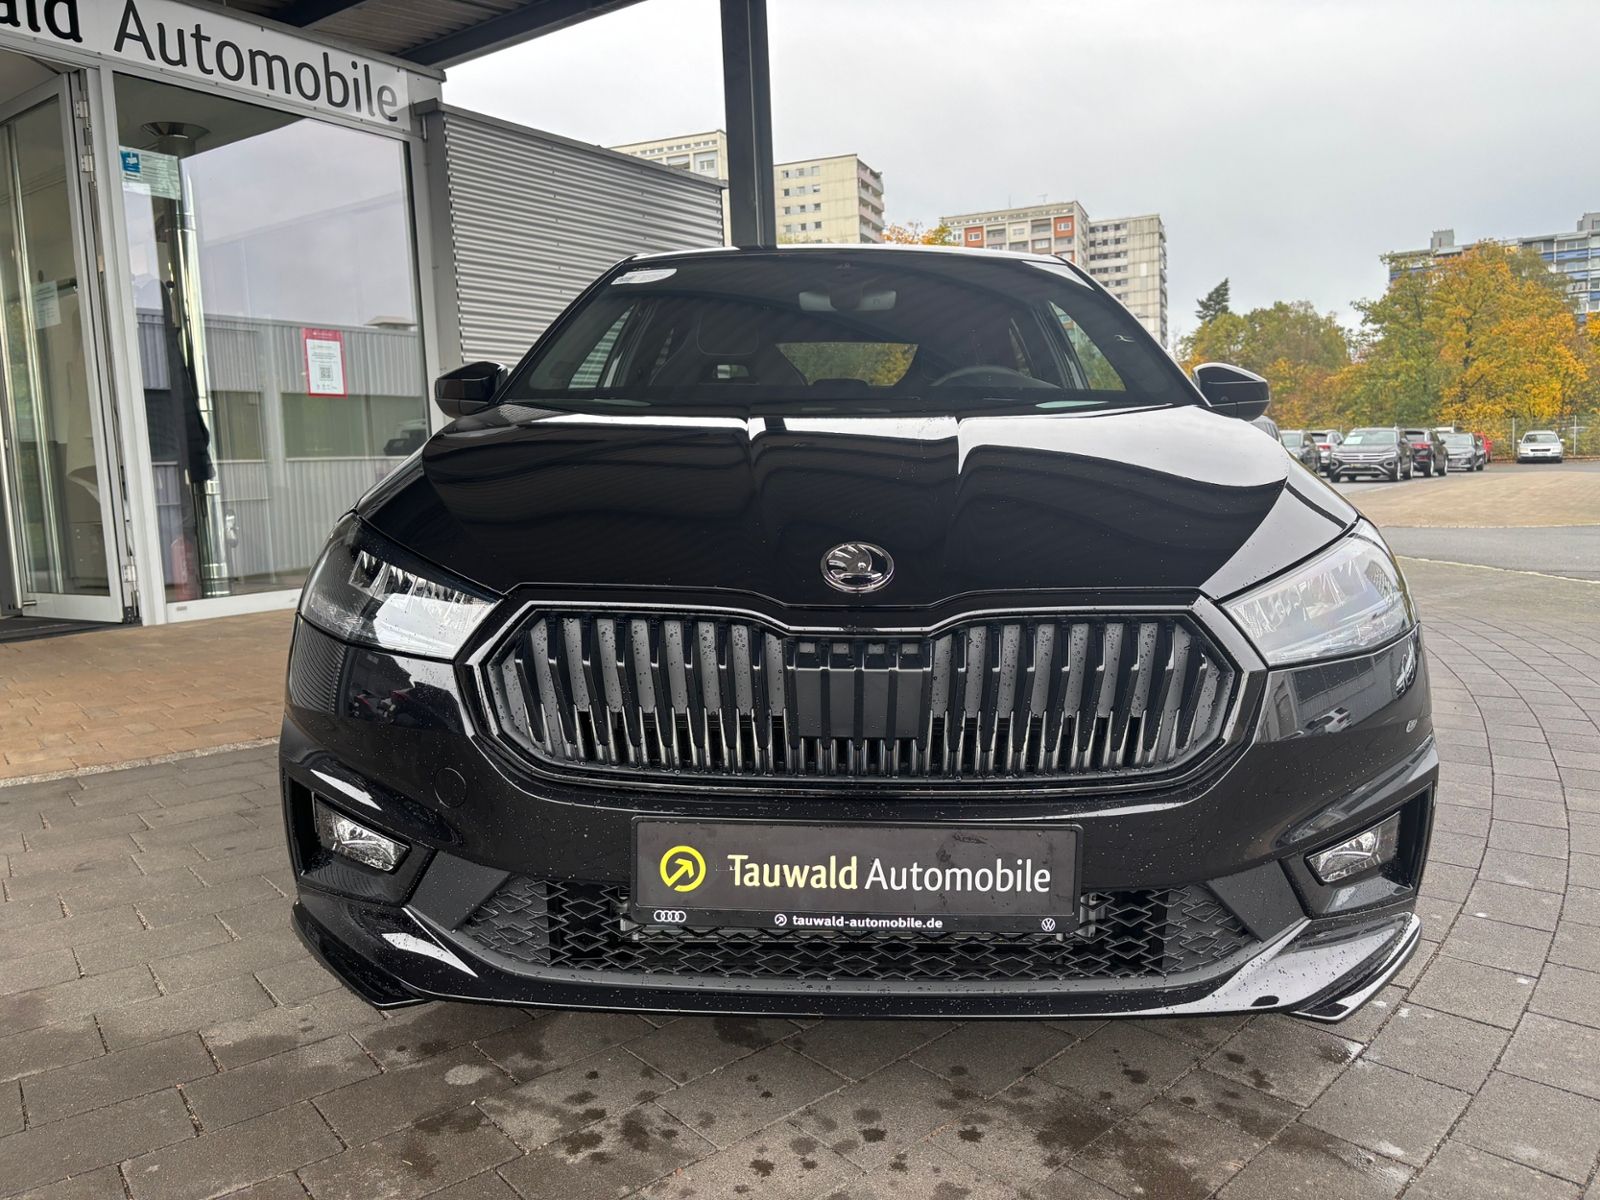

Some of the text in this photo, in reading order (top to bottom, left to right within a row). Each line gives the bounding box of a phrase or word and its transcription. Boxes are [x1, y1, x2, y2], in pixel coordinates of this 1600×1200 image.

[114, 0, 399, 122] Automobile
[727, 854, 1051, 893] Tauwald Automobile
[792, 915, 943, 929] tauwald-automobile.de
